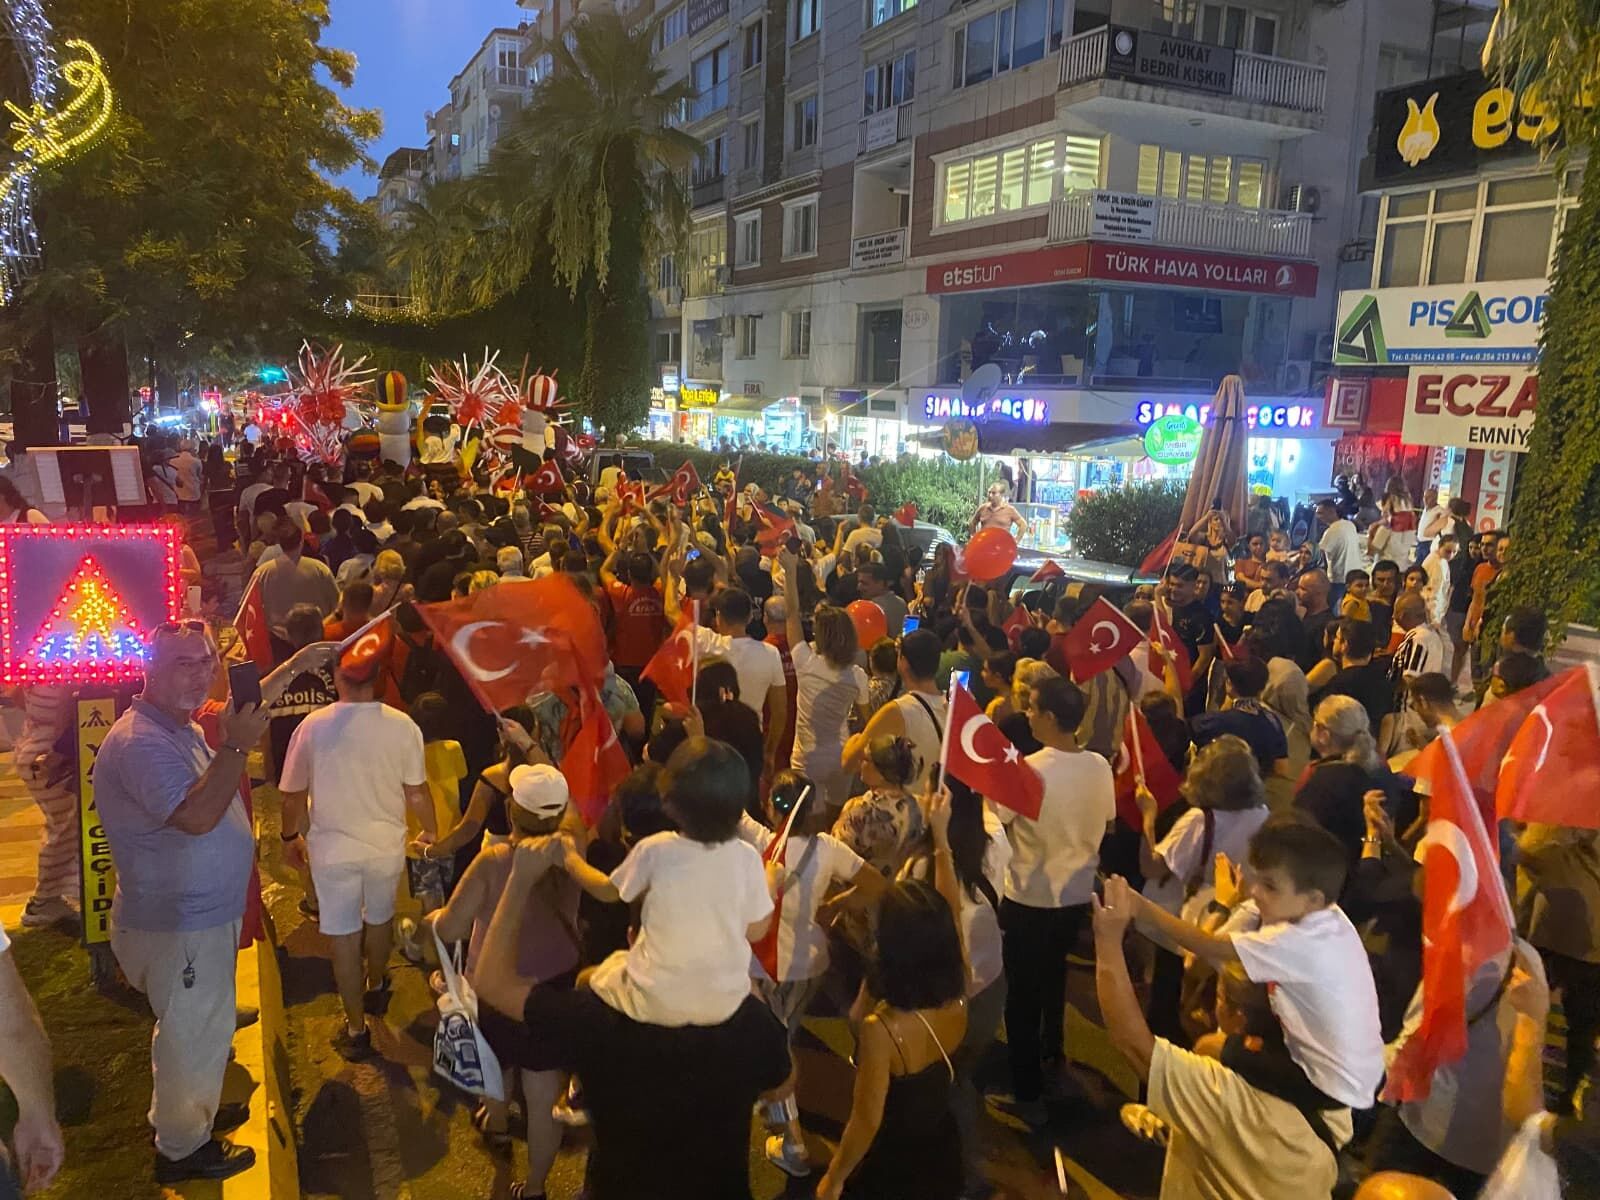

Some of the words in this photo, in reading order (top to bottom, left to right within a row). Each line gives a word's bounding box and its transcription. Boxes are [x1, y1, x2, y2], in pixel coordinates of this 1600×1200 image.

[1160, 40, 1212, 63] AVUKAT
[943, 264, 1003, 287] etstur
[1105, 251, 1149, 274] TÜRK
[1154, 259, 1198, 279] HAVA
[1203, 263, 1268, 285] YOLLARI
[88, 824, 113, 932] GEÇİDİ
